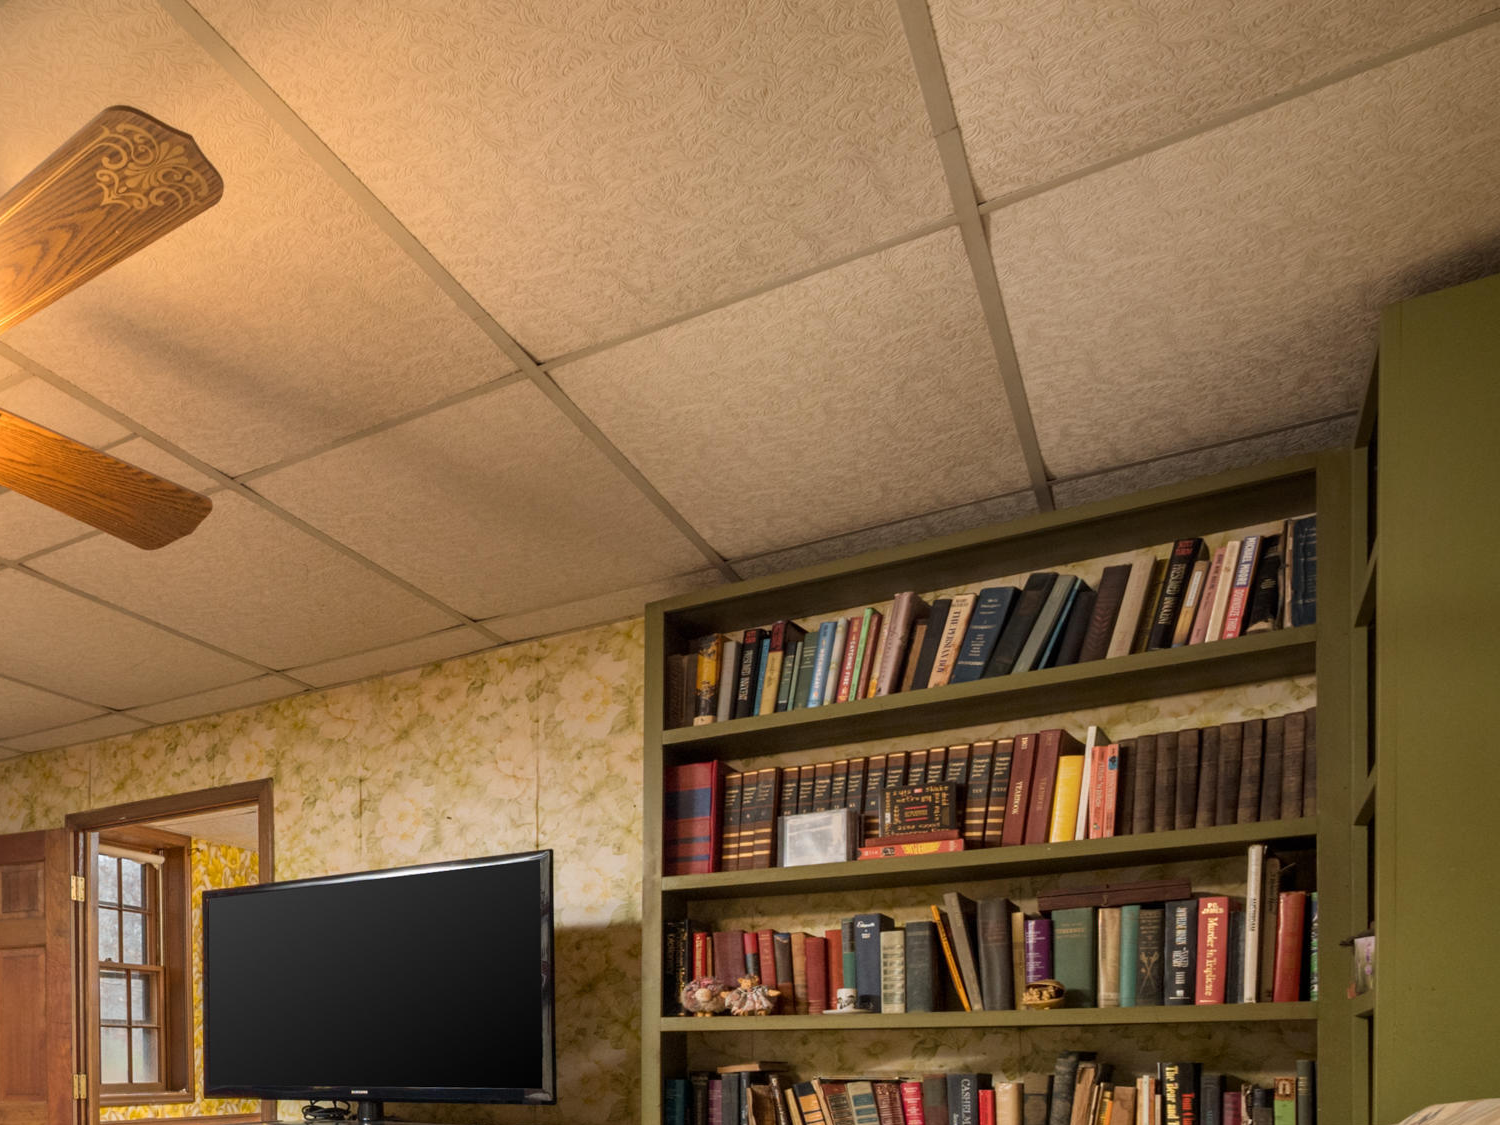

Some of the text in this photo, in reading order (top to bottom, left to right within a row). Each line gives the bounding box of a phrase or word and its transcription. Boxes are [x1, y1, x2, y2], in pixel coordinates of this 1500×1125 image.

[1236, 536, 1257, 586] MICHAEL MOORE
[1166, 563, 1186, 595] PRESUMED
[1158, 596, 1178, 625] INNOCENT
[842, 640, 855, 686] CATCHING FIRE
[1011, 781, 1024, 815] YEARBOOK
[1206, 917, 1219, 948] Murder
[1203, 957, 1217, 997] Triplicate
[1165, 1065, 1179, 1082] The
[1167, 1103, 1180, 1119] and
